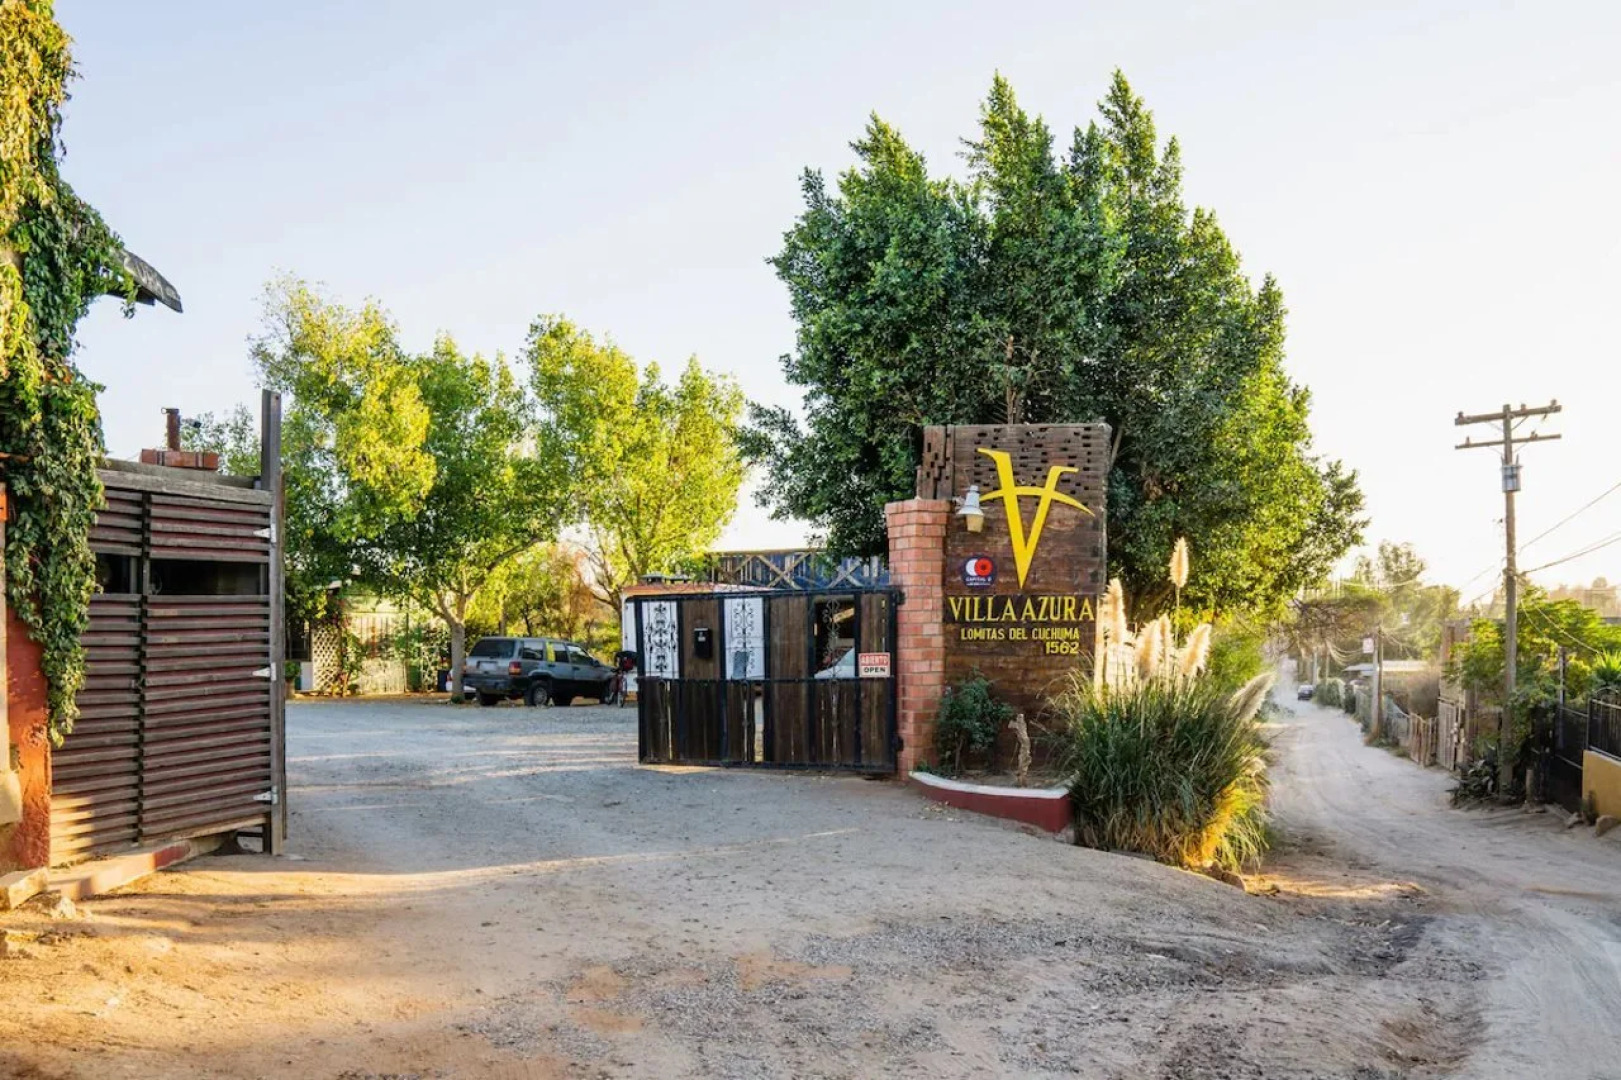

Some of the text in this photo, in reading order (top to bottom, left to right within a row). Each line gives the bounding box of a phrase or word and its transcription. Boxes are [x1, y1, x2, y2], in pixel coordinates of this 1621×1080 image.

[948, 597, 1094, 621] VILLA AZURA
[961, 628, 1080, 640] LOMITAS DEL CUCHUMA
[1045, 641, 1080, 654] 1562
